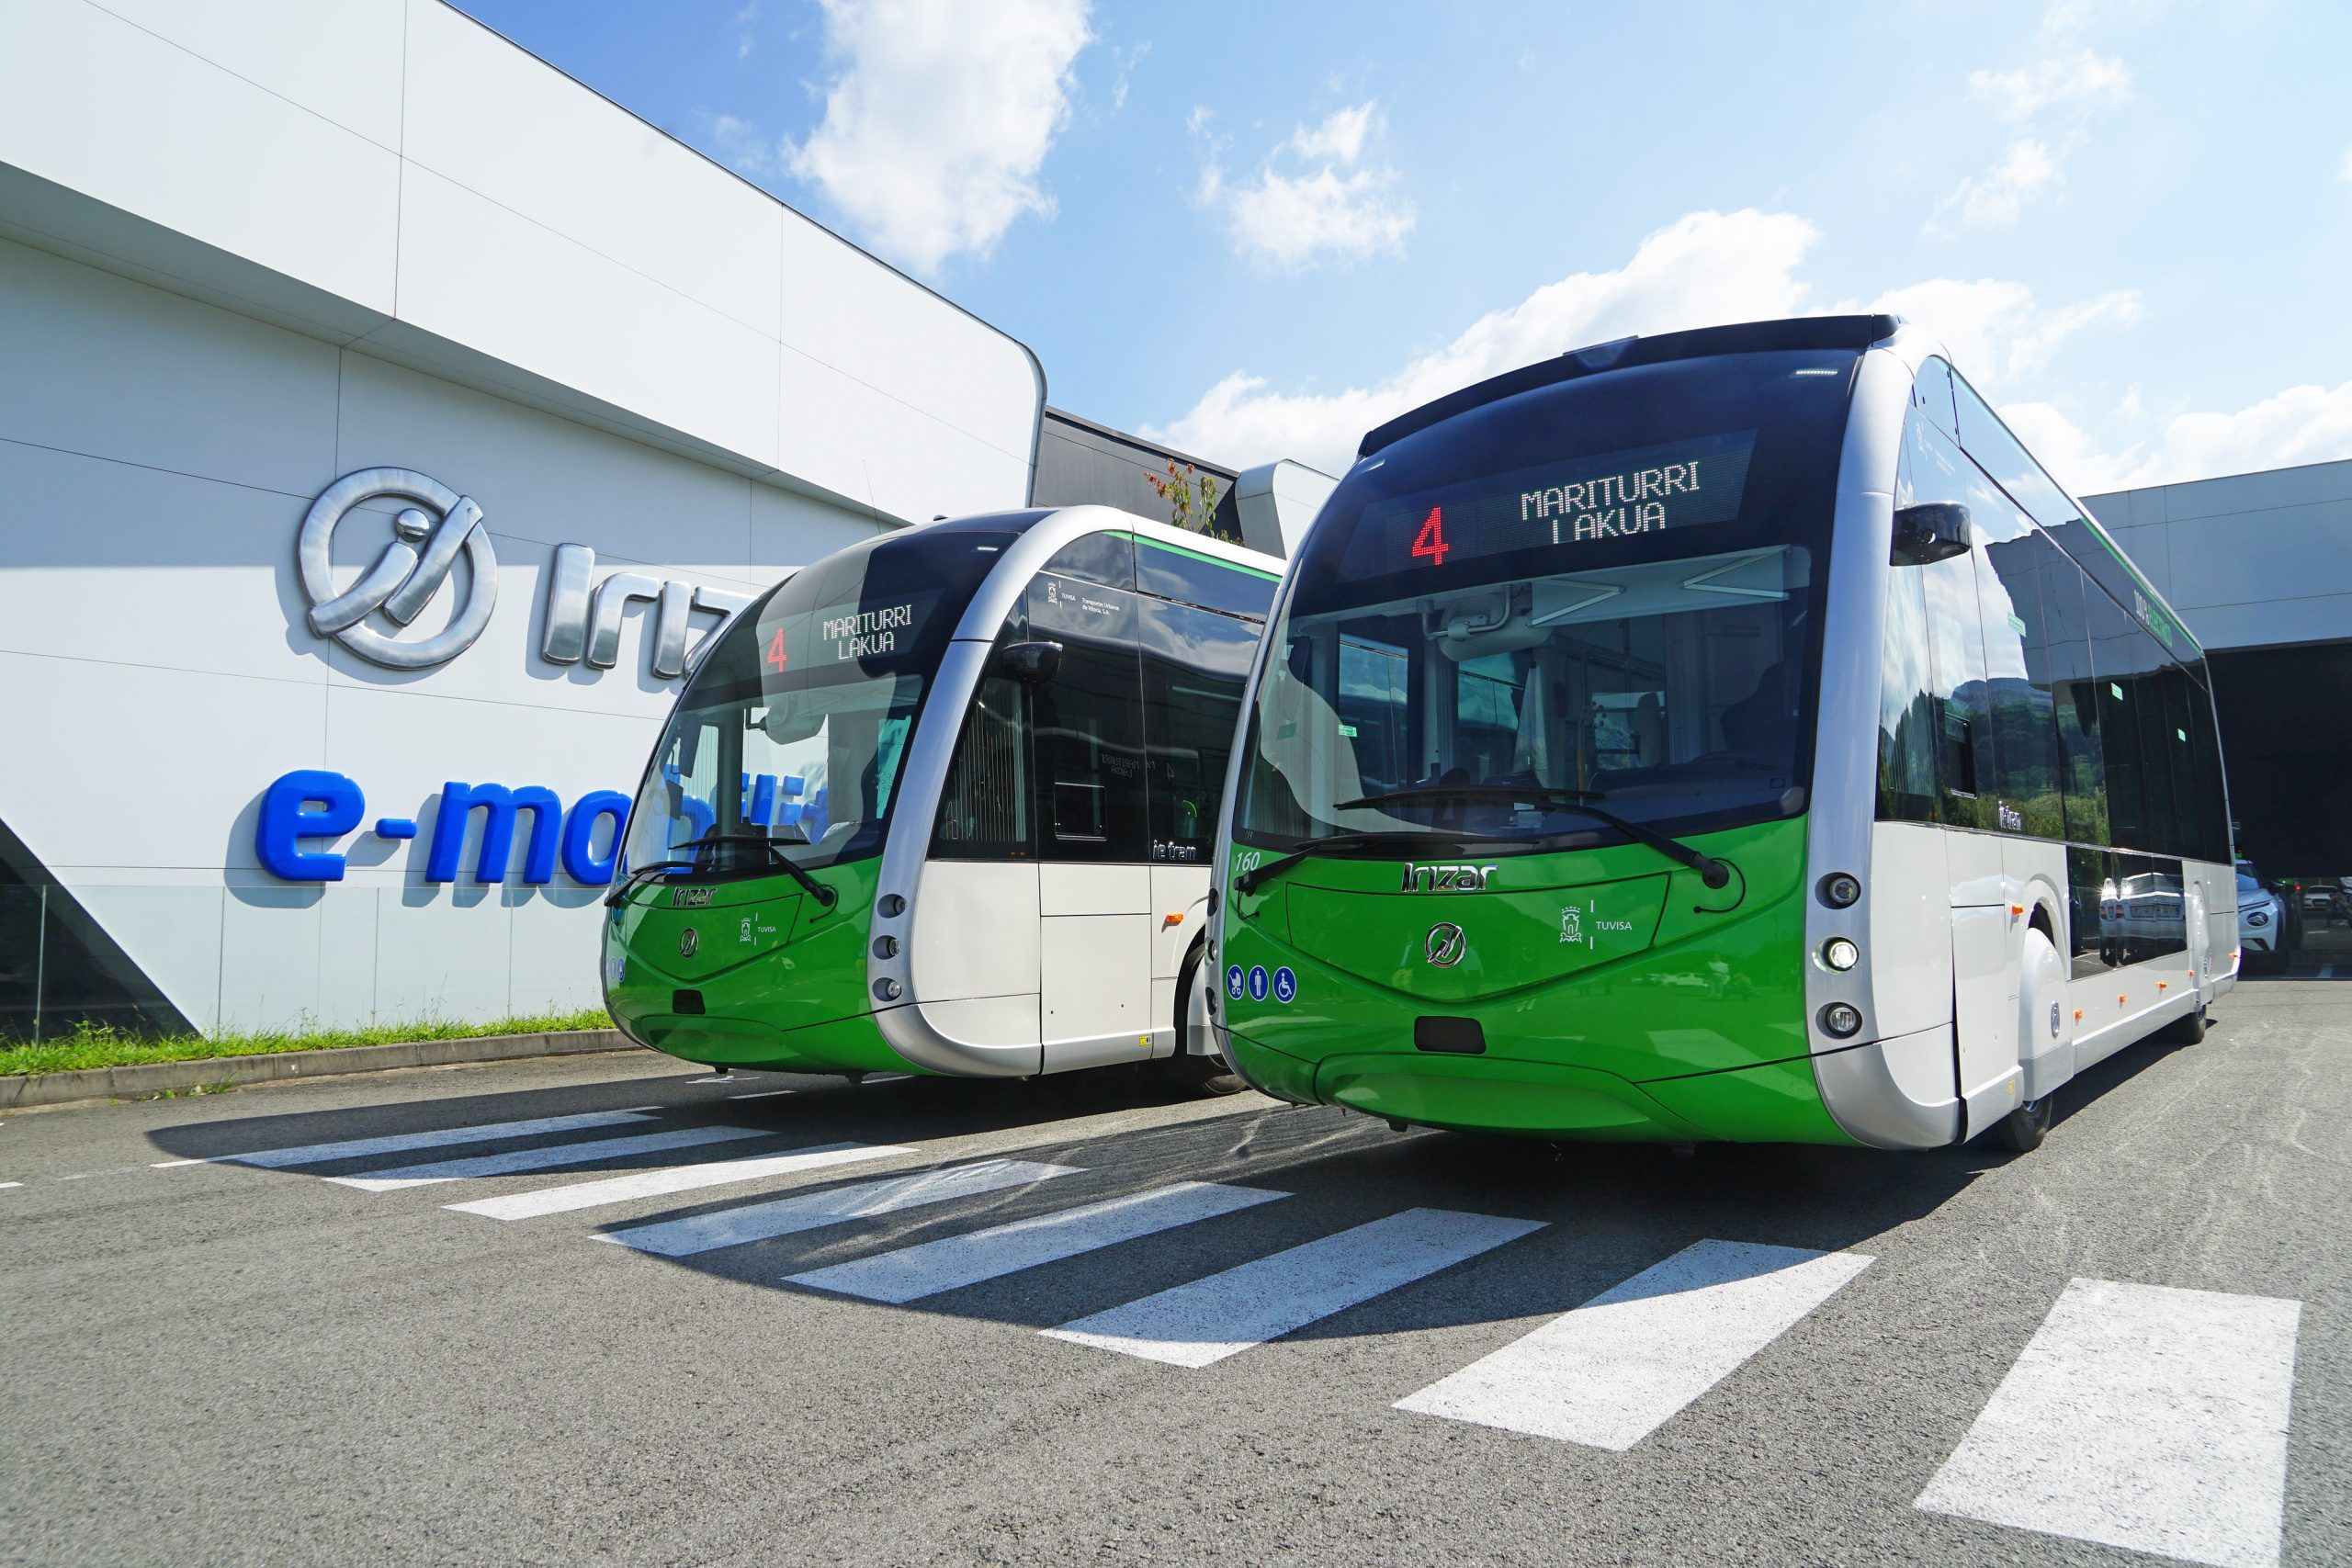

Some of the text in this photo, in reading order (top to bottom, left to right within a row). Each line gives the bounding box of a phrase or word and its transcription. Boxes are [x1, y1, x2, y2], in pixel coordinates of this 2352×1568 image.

[1521, 461, 1700, 521] MARITURRI
[1412, 507, 1449, 566] 4
[543, 543, 759, 680] Iriz
[823, 604, 912, 641] MARITURRI
[766, 627, 787, 673] 4
[838, 631, 895, 660] LAKUA
[1168, 841, 1196, 860] tram
[1236, 852, 1261, 872] 160
[1401, 863, 1498, 892] Irizar
[673, 886, 718, 907] Irizar
[1595, 920, 1633, 931] TUVISA
